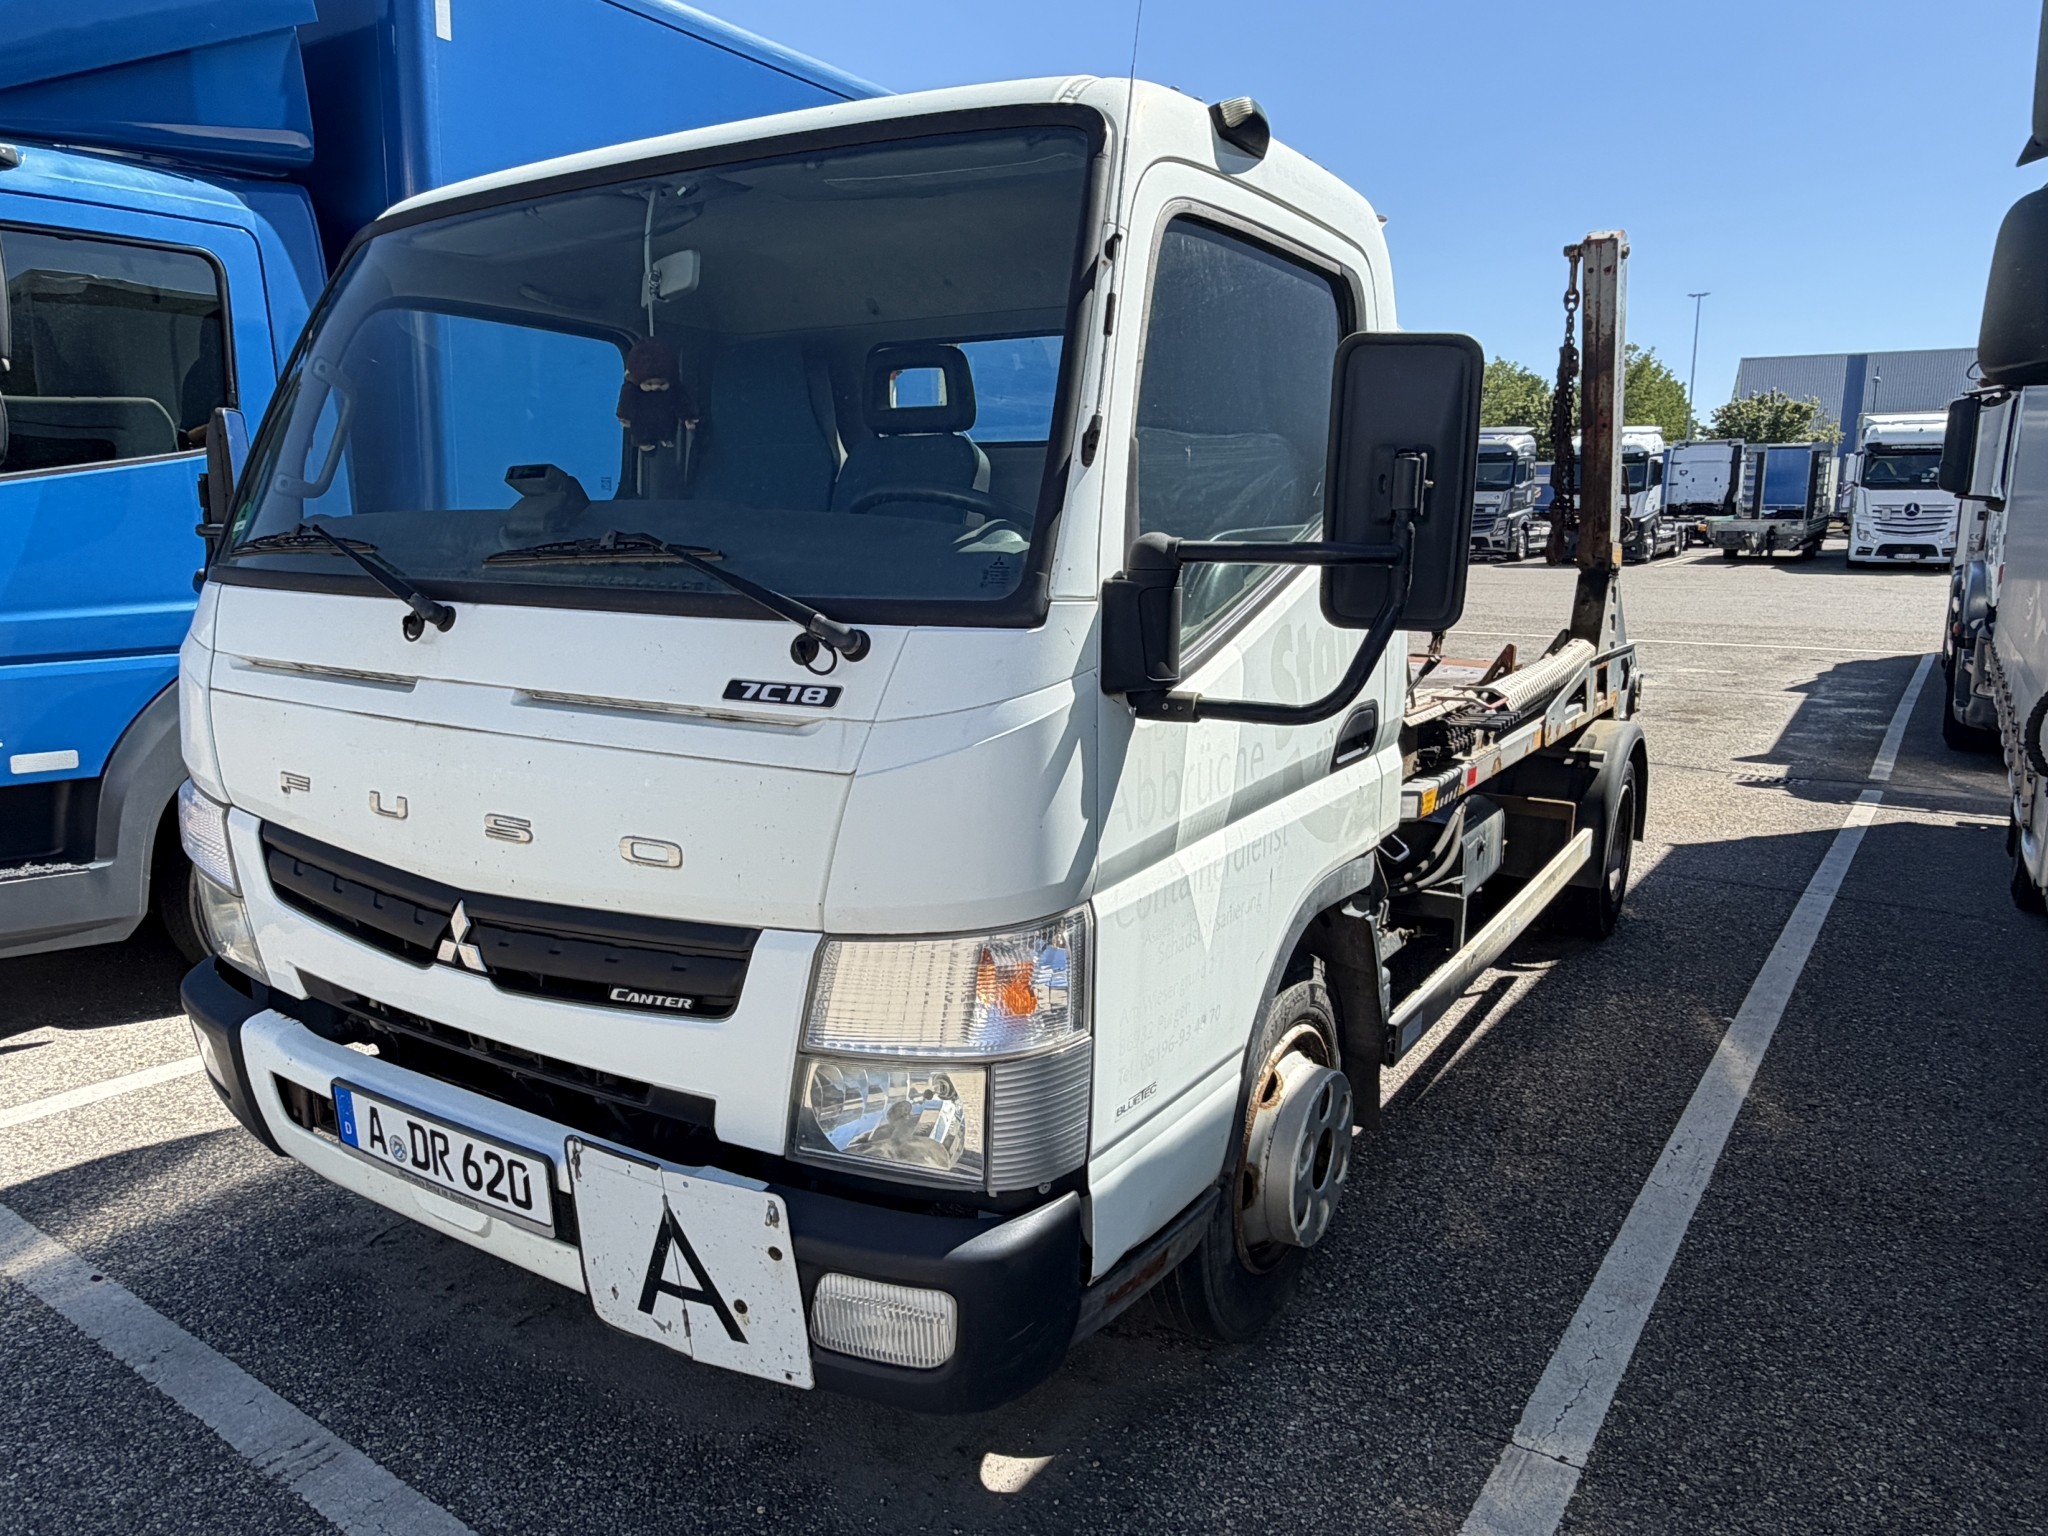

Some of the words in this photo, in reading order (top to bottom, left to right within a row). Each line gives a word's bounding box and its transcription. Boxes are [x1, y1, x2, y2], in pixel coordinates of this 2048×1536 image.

[740, 682, 829, 705] 7C18
[280, 771, 683, 870] FUSO
[609, 987, 697, 1010] CANTER
[1116, 1080, 1158, 1117] BLUETEC
[345, 1121, 353, 1135] D
[369, 1105, 388, 1155] A
[406, 1120, 455, 1183] DR
[462, 1142, 533, 1211] 620
[637, 1204, 750, 1345] A
